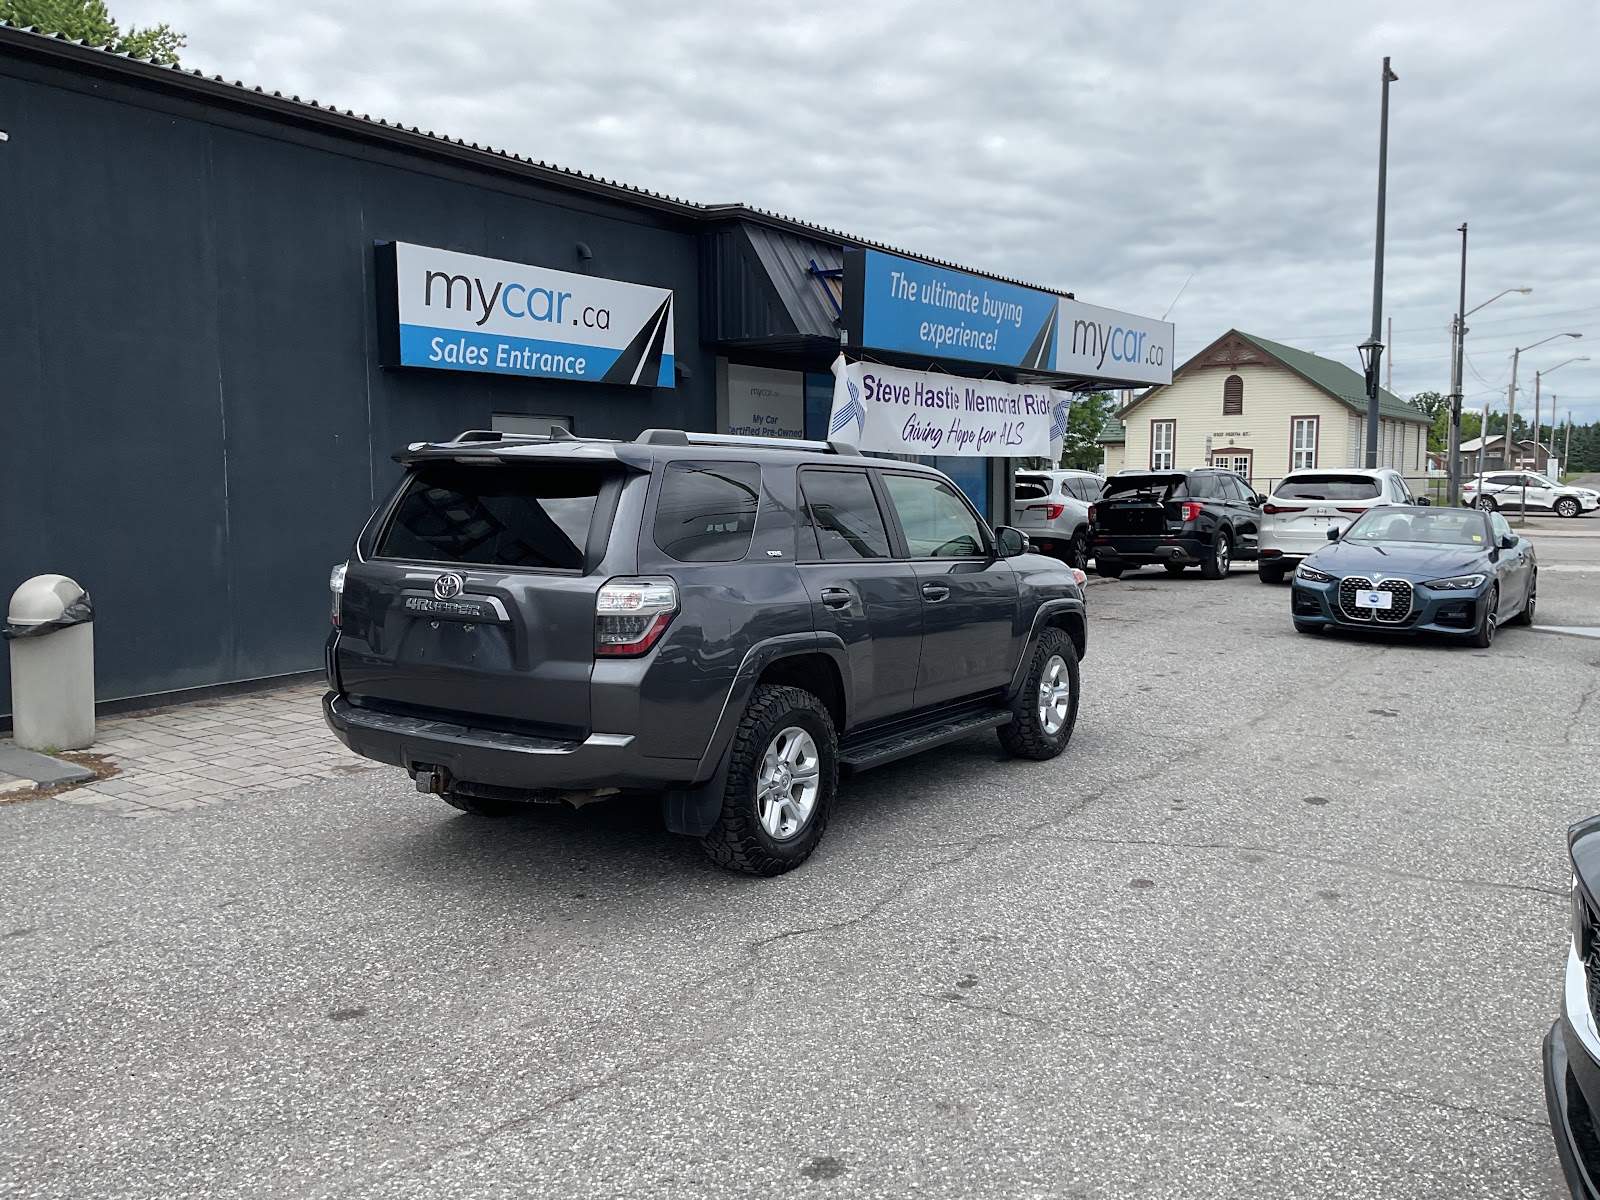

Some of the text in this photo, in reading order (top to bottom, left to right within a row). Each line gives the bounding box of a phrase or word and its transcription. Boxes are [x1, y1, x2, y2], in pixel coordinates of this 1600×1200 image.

[424, 269, 611, 331] mycar.ca
[890, 271, 1023, 328] The ultimate buying
[428, 336, 586, 375] Sales Entrance
[919, 321, 999, 352] experience!
[1071, 318, 1165, 371] mycar.ca
[862, 374, 911, 405] Steve
[914, 381, 960, 410] Hastie
[964, 388, 1021, 415] Memorial
[752, 414, 779, 425] My Car
[762, 427, 803, 438] Pre-Owned
[902, 412, 1025, 452] Giving Hope for ALS
